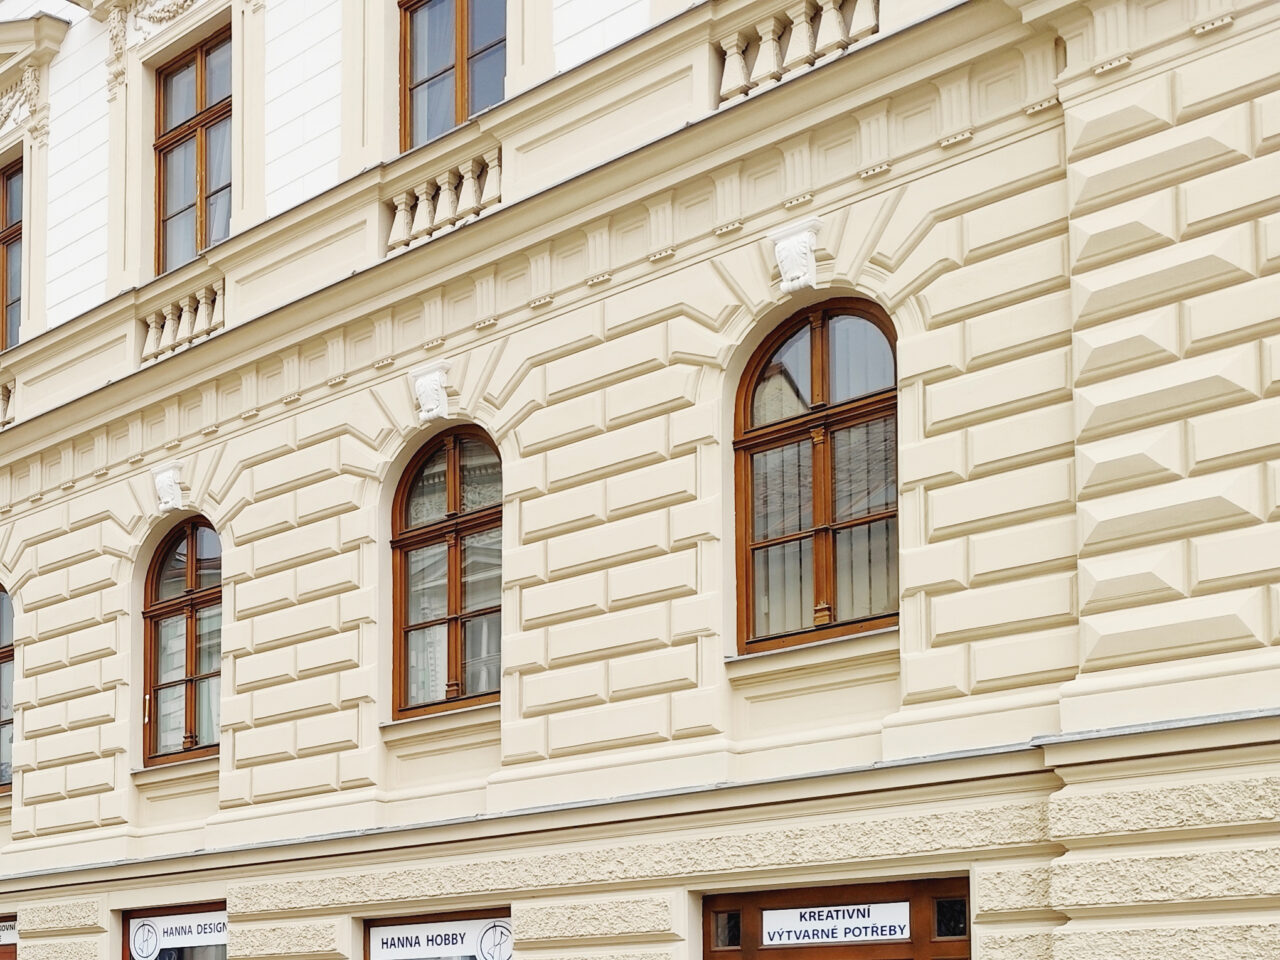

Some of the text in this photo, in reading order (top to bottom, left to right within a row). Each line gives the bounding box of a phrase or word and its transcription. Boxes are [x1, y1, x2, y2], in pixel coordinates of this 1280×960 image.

[799, 904, 872, 922] KREATIVNÍ
[162, 925, 193, 938] HANNA
[767, 923, 907, 942] VÝTVARNÉ POTŘEBY
[381, 932, 467, 950] HANNA HOBBY
